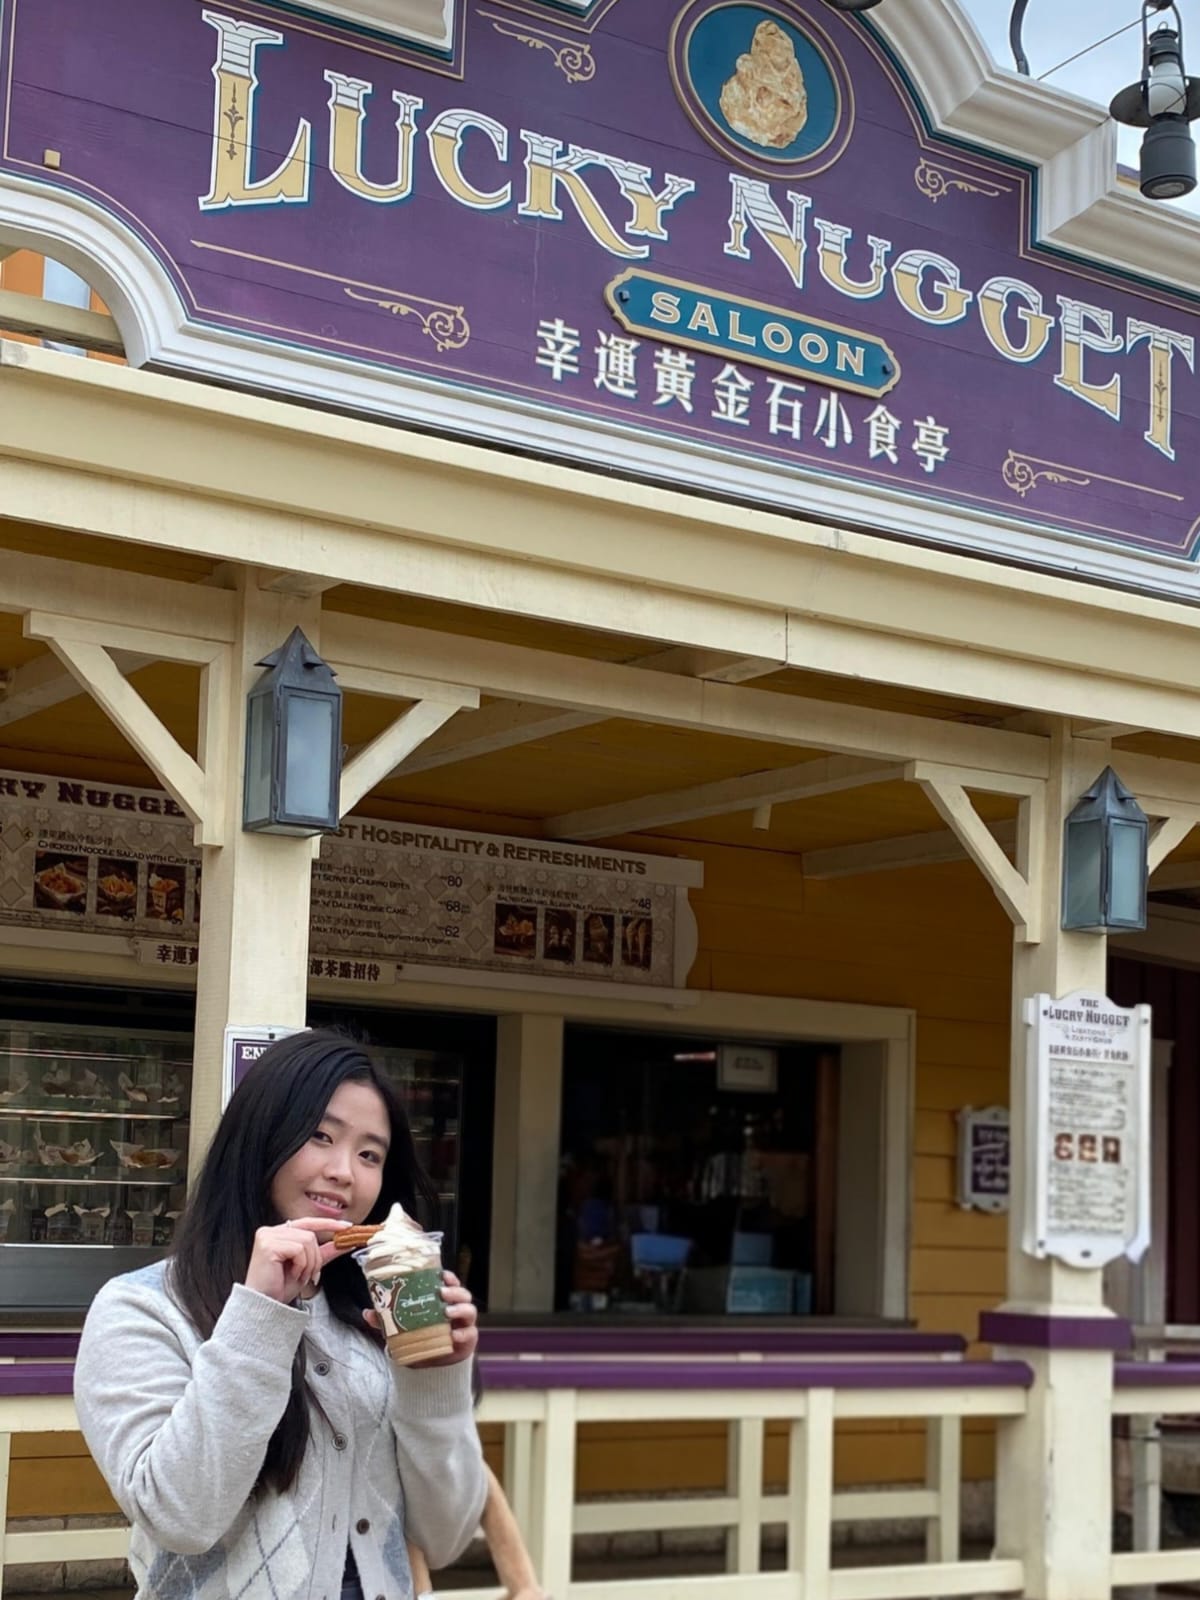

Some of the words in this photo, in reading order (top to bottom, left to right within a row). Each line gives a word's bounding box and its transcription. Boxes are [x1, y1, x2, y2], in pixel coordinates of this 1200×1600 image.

[199, 8, 696, 259] LUCKY
[722, 172, 1195, 461] NUGGET
[648, 289, 866, 377] SALOON
[535, 316, 951, 474] 幸運黃金石小食亭
[361, 824, 485, 857] HOSPITALITY
[486, 842, 500, 857] &
[502, 842, 648, 875] REFRESHMENTS
[447, 875, 463, 888] 80
[446, 900, 461, 913] 68
[638, 898, 652, 910] 48
[445, 925, 460, 938] 62
[1080, 998, 1099, 1008] THE
[1049, 1006, 1084, 1022] LUCKY
[1086, 1009, 1130, 1027] NUGGET
